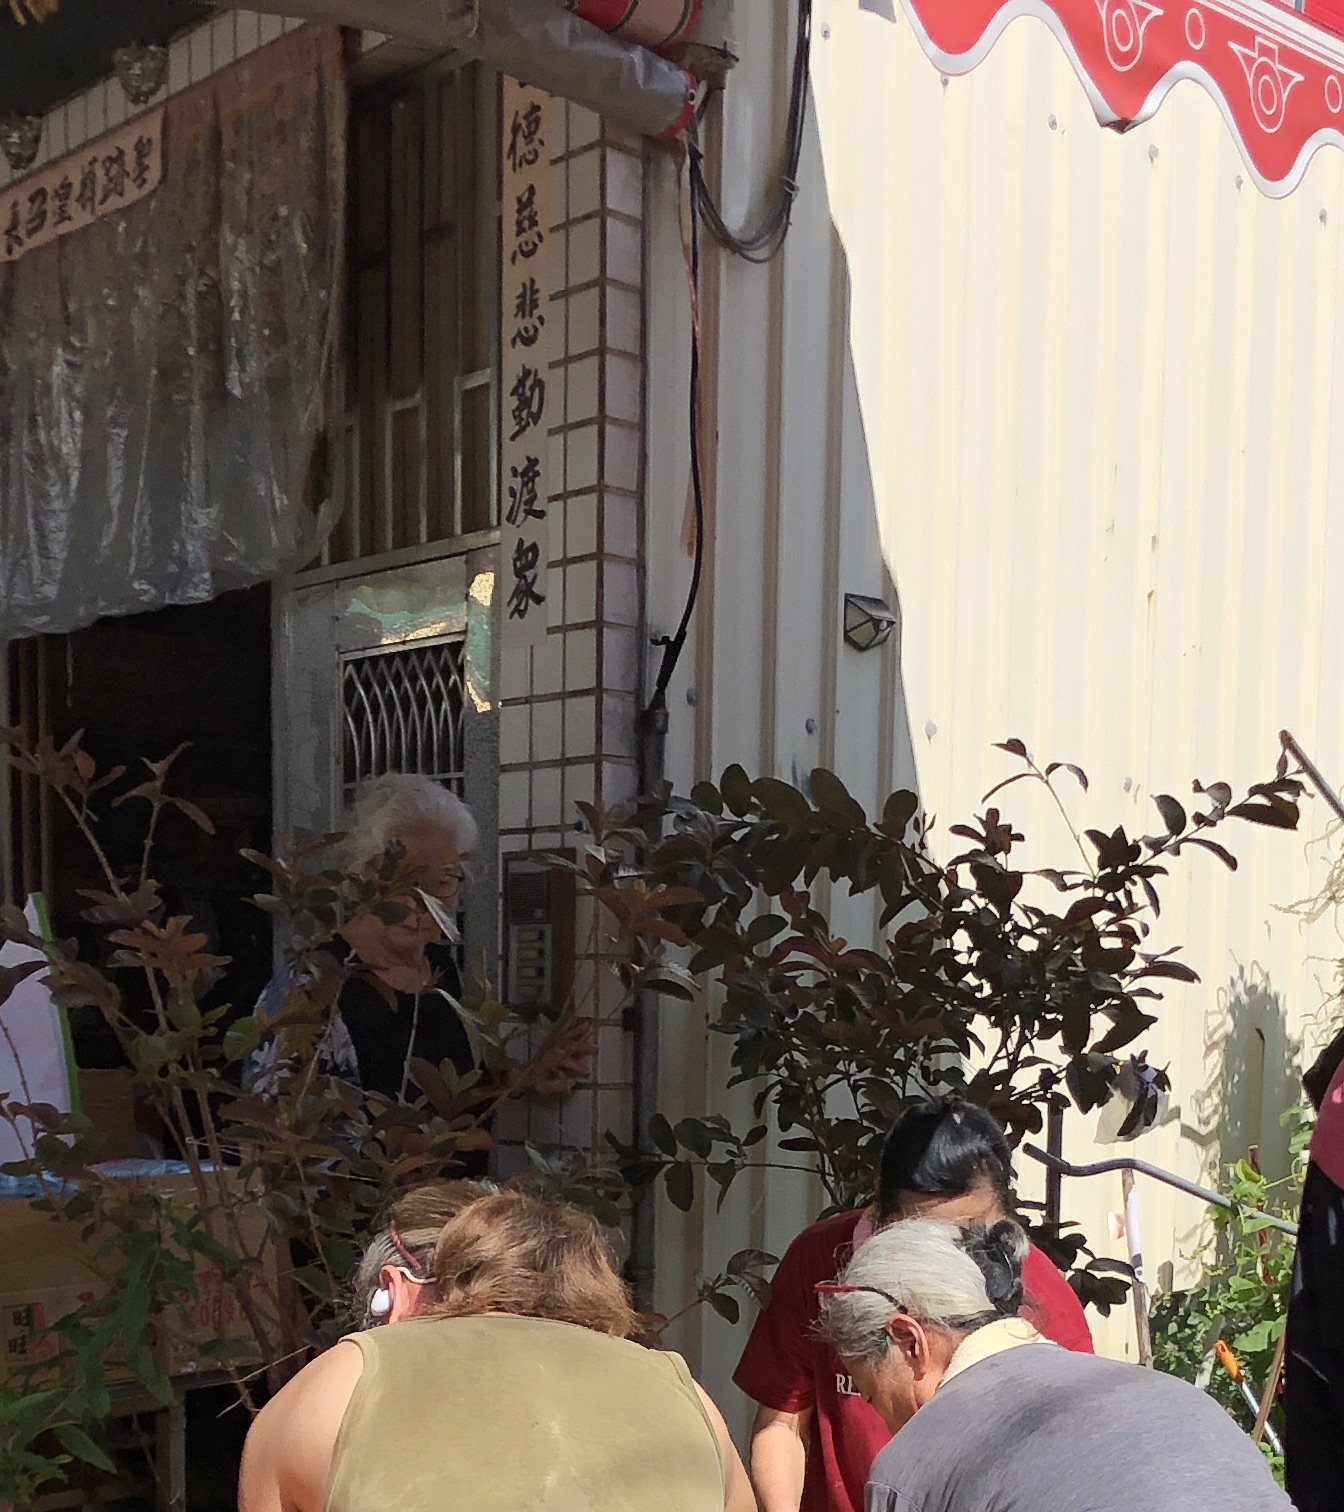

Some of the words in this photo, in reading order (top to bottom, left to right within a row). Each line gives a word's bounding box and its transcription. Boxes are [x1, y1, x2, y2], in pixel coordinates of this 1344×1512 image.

[507, 84, 546, 621] 德慈悲勤渡眾
